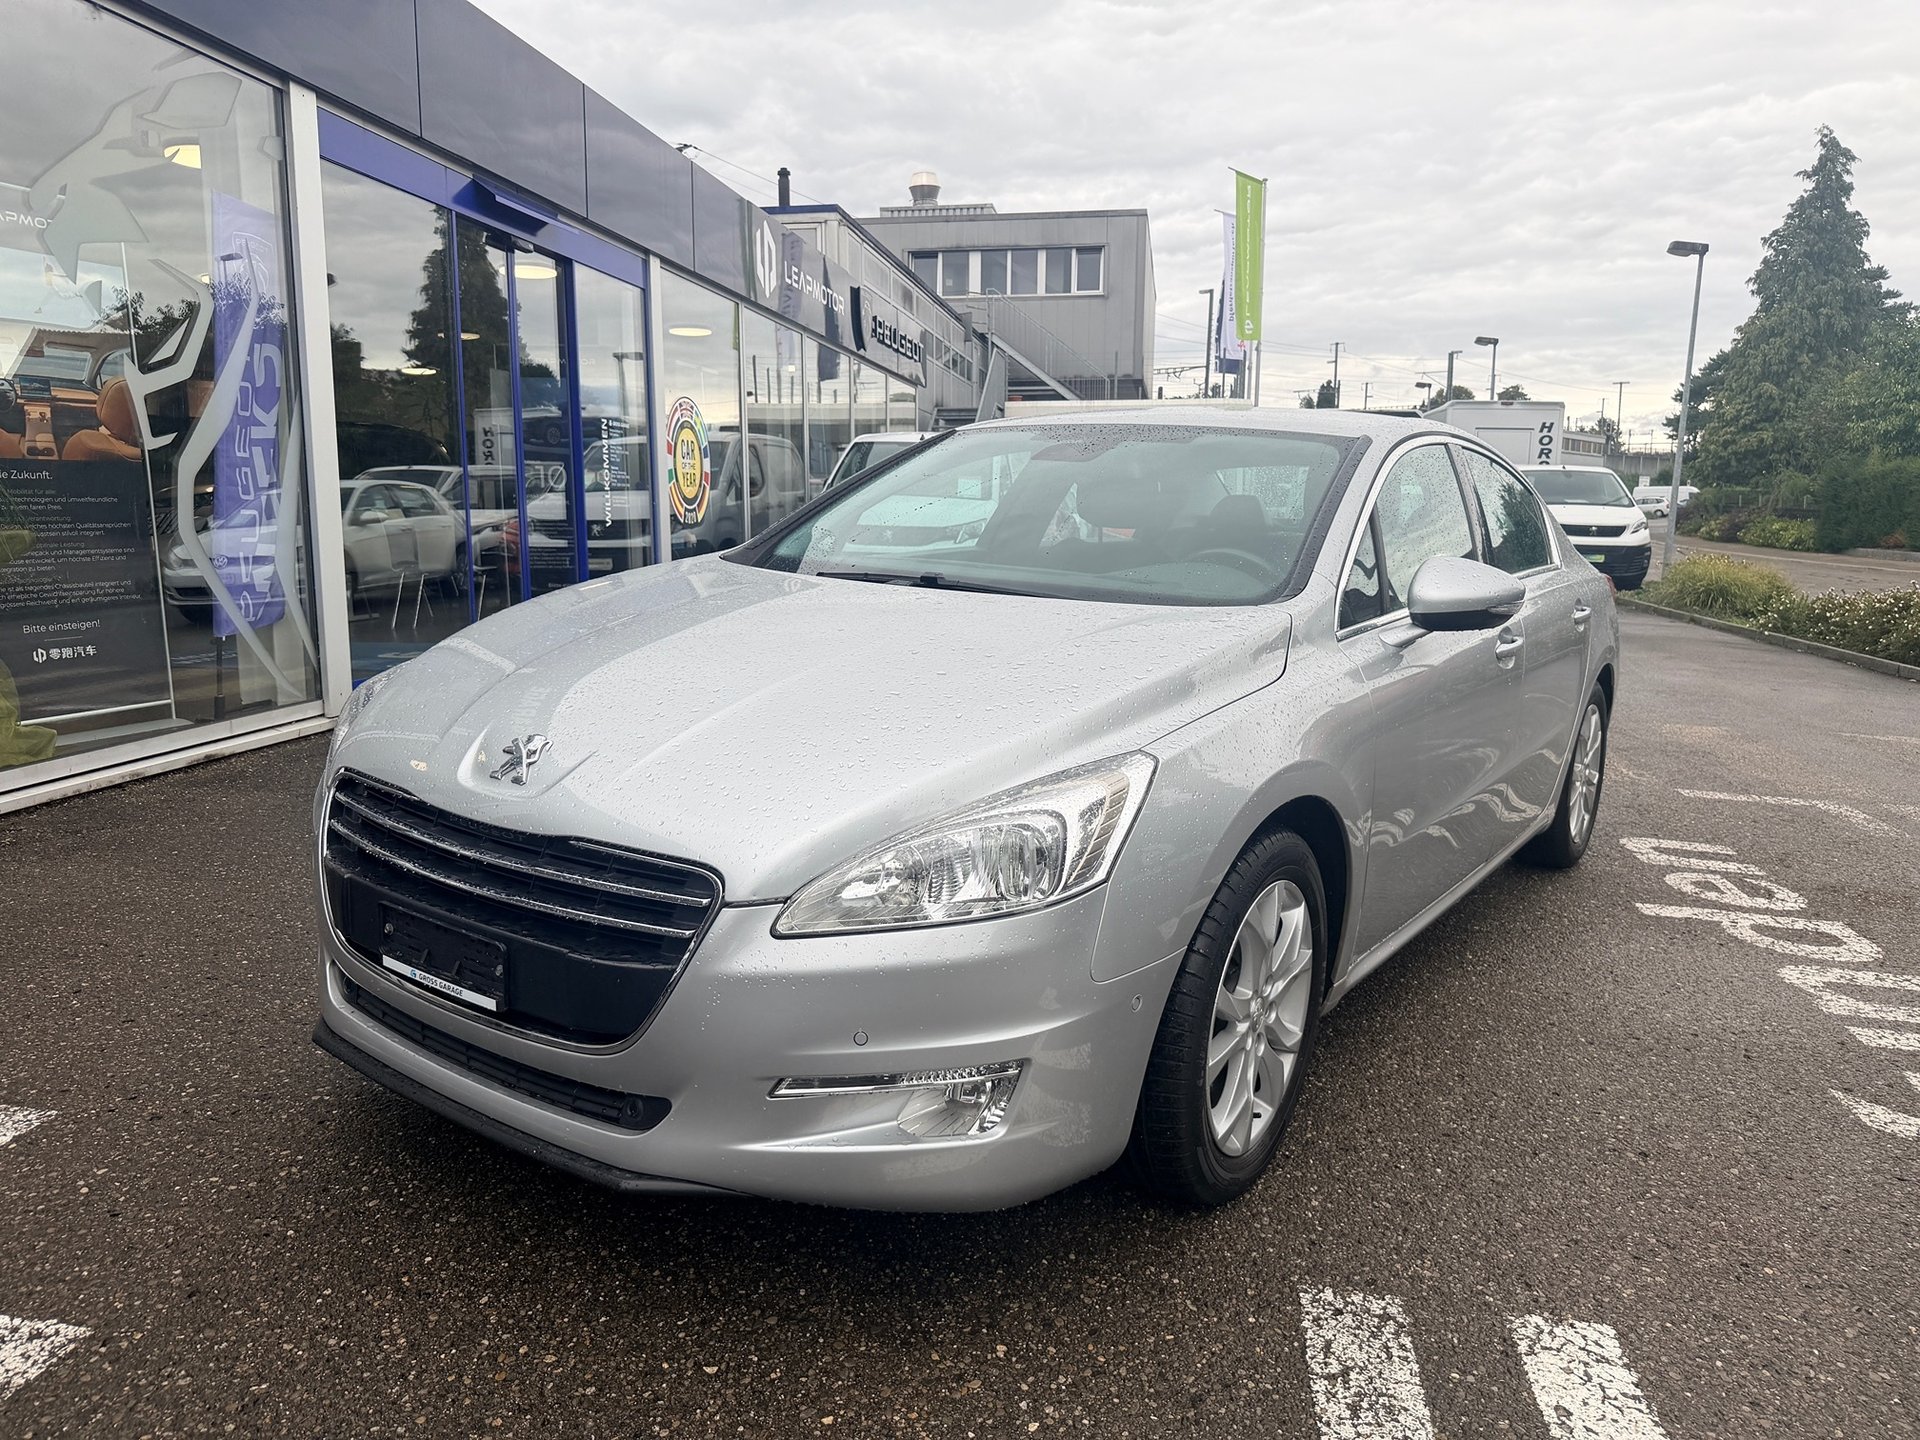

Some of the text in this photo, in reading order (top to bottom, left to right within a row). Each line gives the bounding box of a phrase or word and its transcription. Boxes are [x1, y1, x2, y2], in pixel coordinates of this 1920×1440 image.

[784, 260, 845, 316] LEAPMOTOR
[681, 439, 696, 461] CAR
[10, 469, 53, 480] Zukunft.
[601, 418, 613, 528] WILLKOMMEN
[681, 472, 697, 488] YEAR
[684, 511, 697, 525] 2020
[22, 619, 101, 634] Bitte einsteigen!
[418, 973, 439, 987] GROSS
[438, 980, 464, 997] GARAGE
